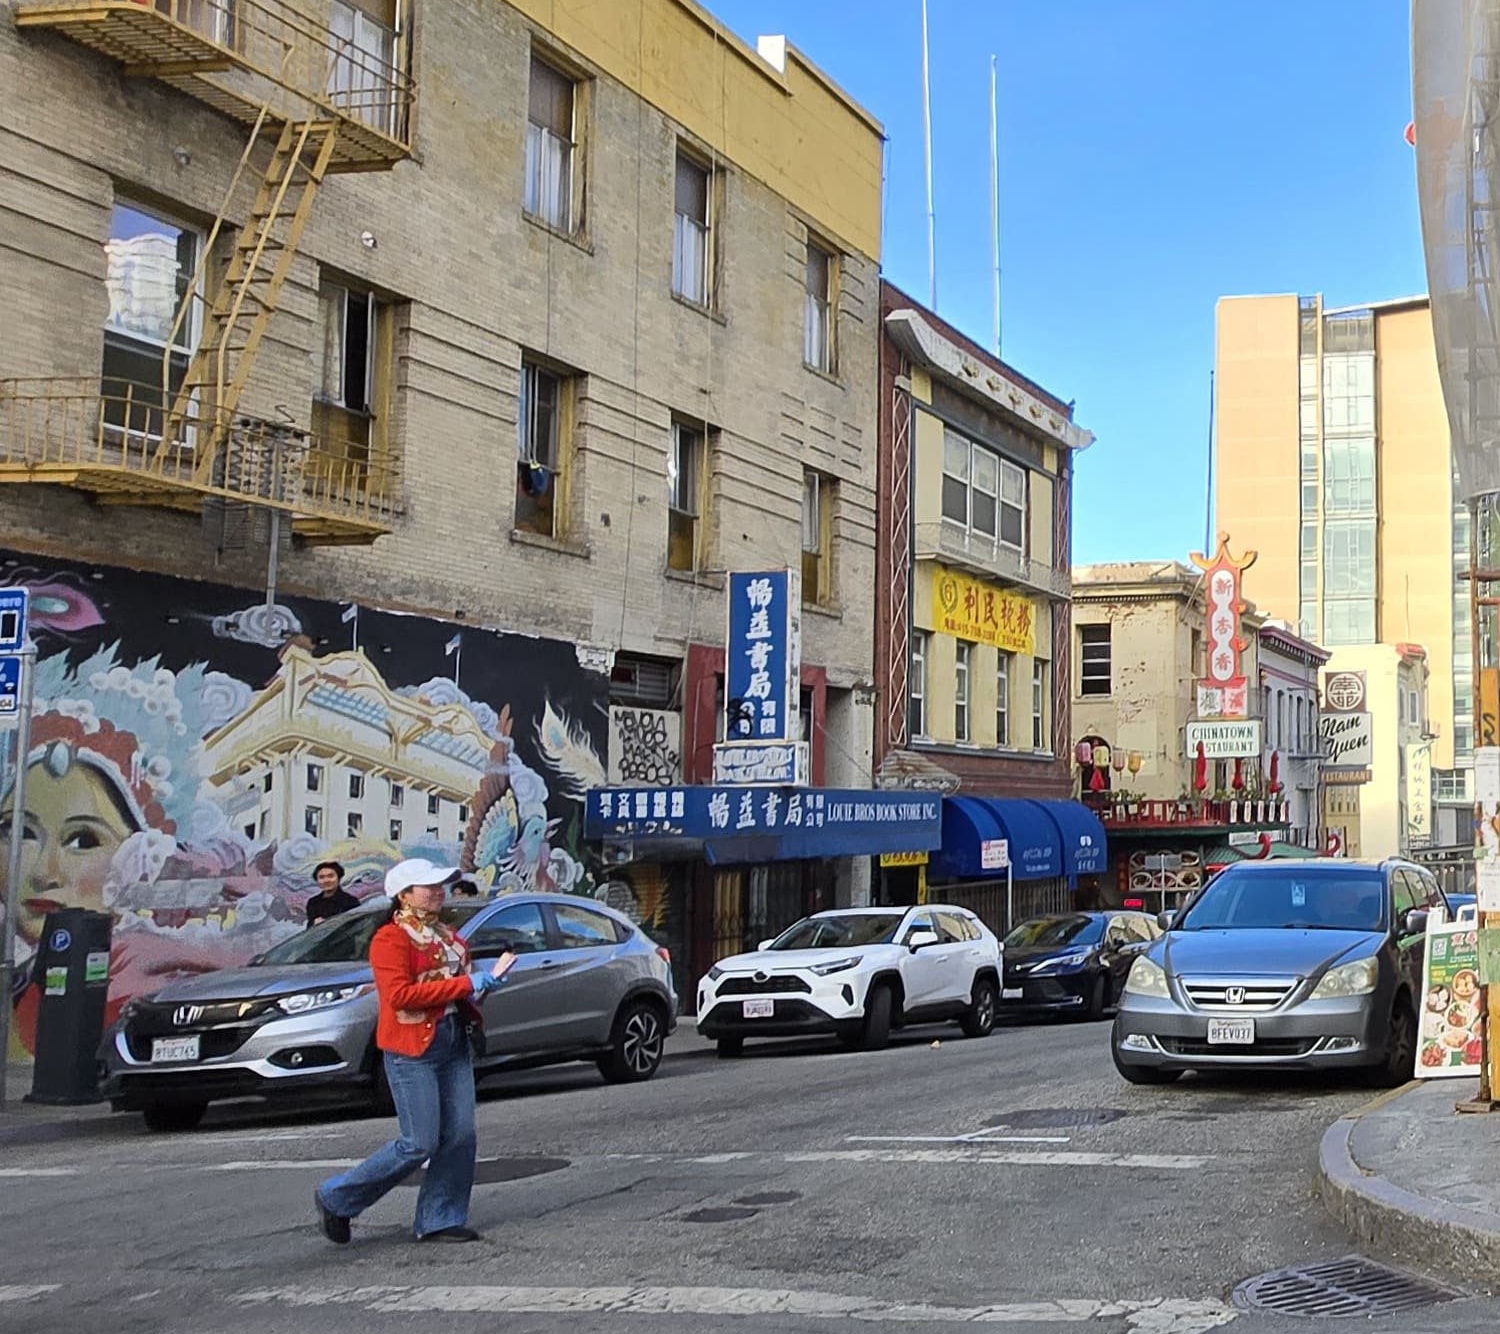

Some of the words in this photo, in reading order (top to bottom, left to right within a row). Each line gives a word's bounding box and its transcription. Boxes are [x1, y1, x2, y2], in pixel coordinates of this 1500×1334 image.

[1214, 577, 1232, 671] 新杏香
[1192, 726, 1254, 740] CHINATOWN
[1322, 715, 1361, 738] Nam
[1192, 741, 1254, 753] STAURANT
[1326, 734, 1368, 763] Yuen
[827, 802, 853, 822] LOUIE
[854, 802, 875, 822] BROS
[876, 802, 897, 821] BOOK
[898, 802, 921, 821] STORE
